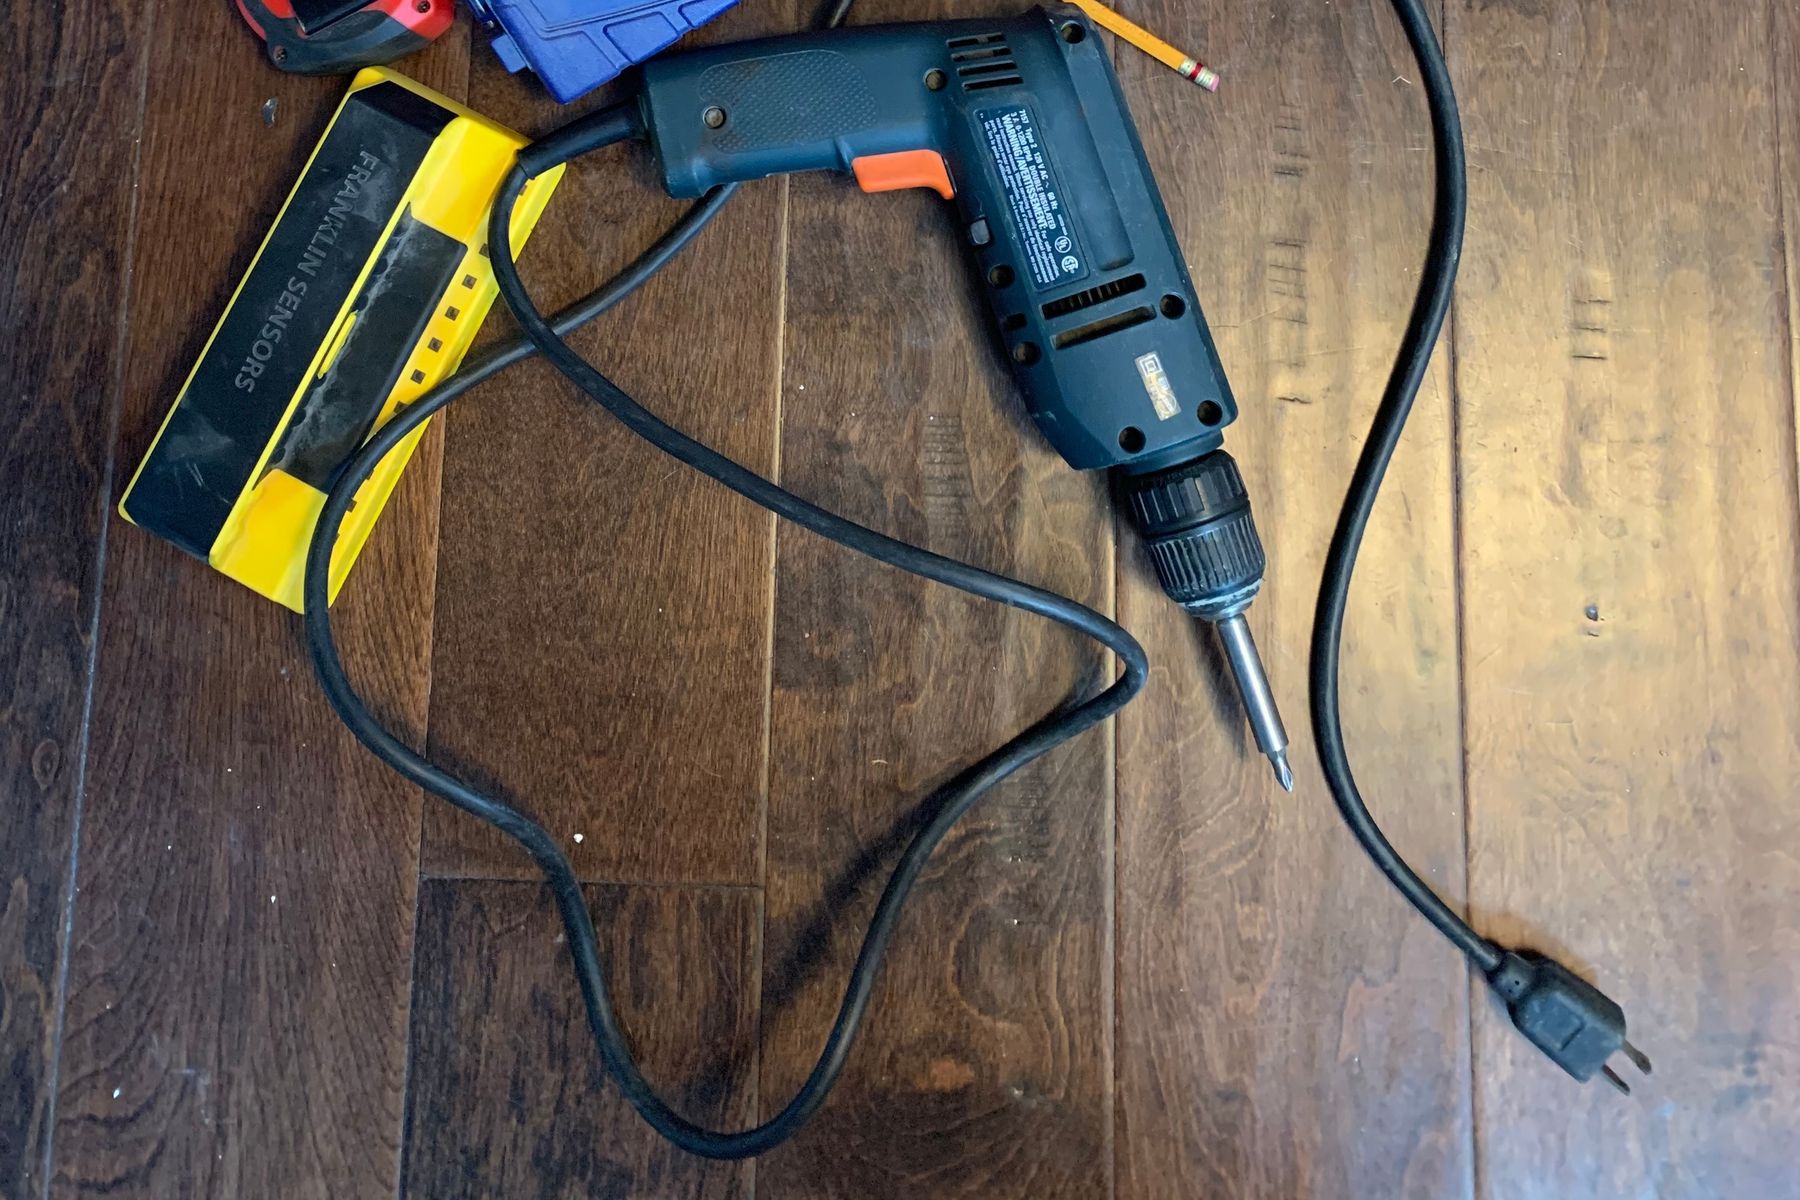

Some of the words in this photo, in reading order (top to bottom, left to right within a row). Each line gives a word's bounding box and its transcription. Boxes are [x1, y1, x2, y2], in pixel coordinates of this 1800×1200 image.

[297, 150, 379, 278] FRANKLIN
[1019, 109, 1029, 123] 7157
[1025, 127, 1034, 143] Type
[1039, 170, 1048, 180] AC
[1050, 200, 1058, 210] Hz
[1022, 145, 1033, 162] RPM
[1029, 165, 1043, 192] DOUBLE
[1038, 192, 1056, 229] INSULATED
[234, 276, 308, 393] SENSORS
